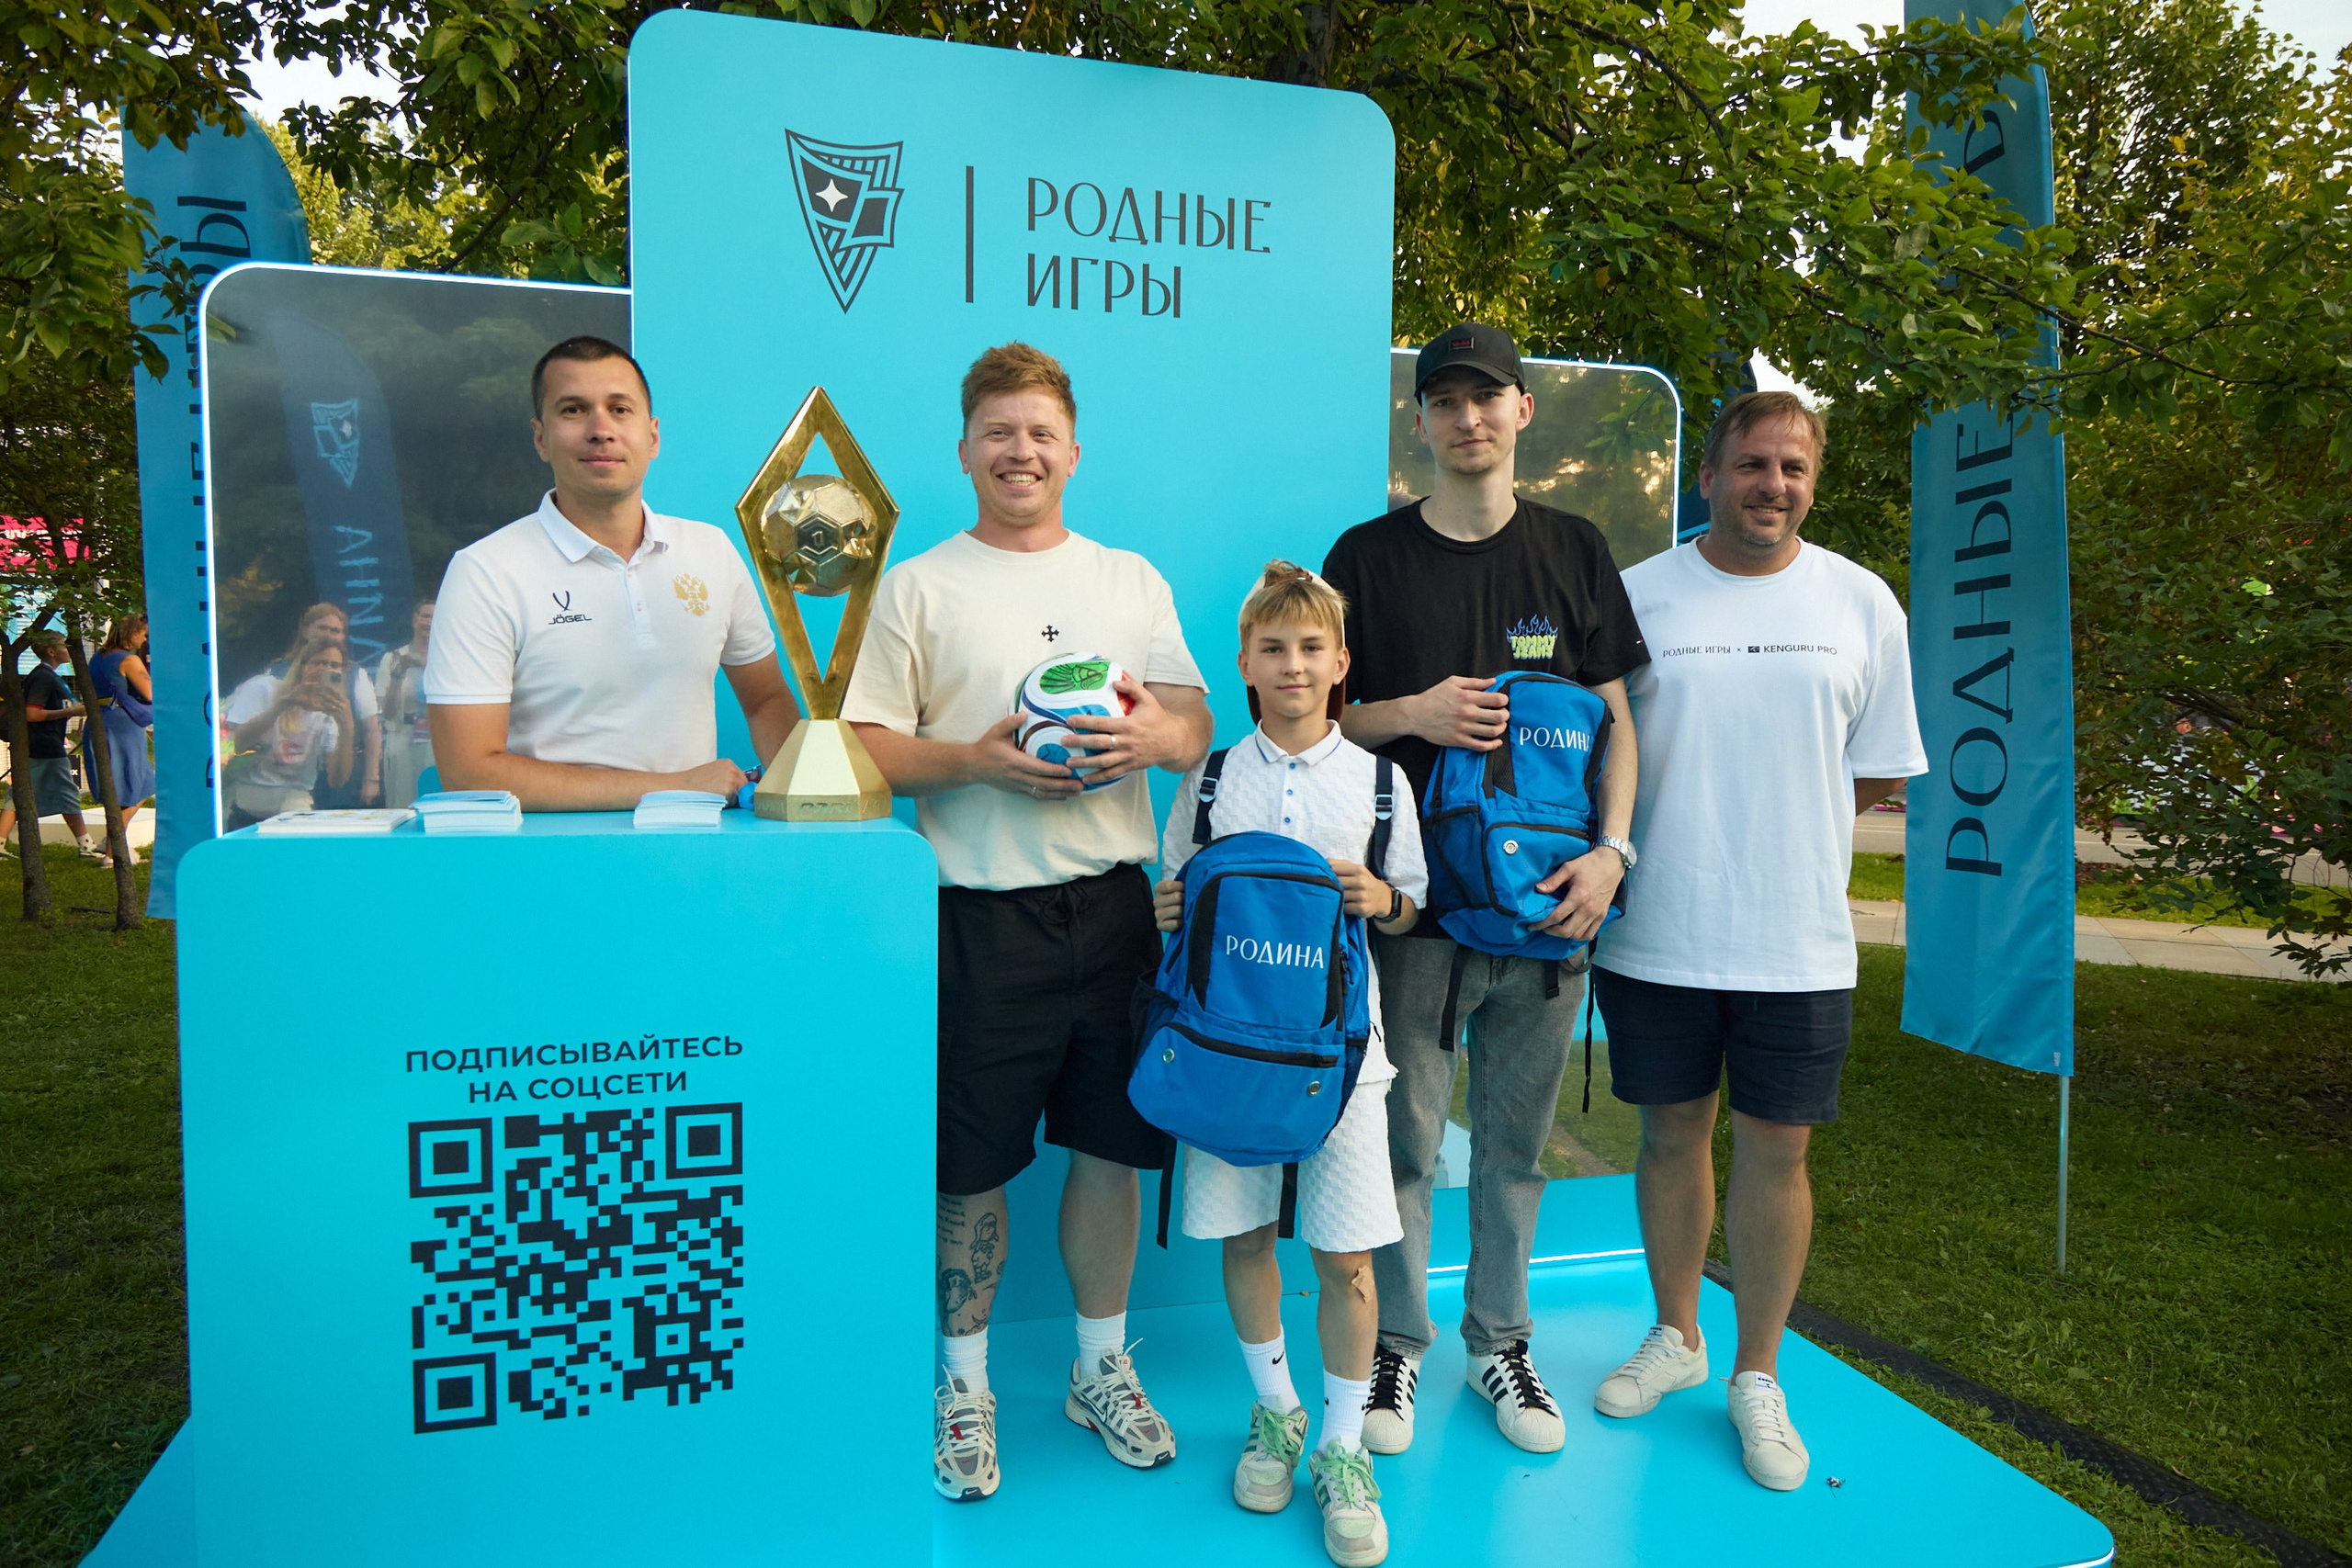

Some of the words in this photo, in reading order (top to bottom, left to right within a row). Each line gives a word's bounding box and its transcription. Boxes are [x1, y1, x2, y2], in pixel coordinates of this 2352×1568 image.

[1026, 175, 1272, 254] РОДНЫЕ
[1026, 253, 1182, 319] ИГРЫ
[548, 614, 593, 626] JÖGEL
[1510, 635, 1556, 649] TOMMY
[1512, 645, 1555, 660] JEANS
[1663, 645, 1702, 658] РОДНЫЕ
[1705, 645, 1731, 654] ИГРЫ
[1763, 645, 1815, 653] KENGURU
[1817, 645, 1838, 655] PRO
[1945, 413, 2015, 877] РОДНЫЕ
[1226, 934, 1324, 970] РОДИНА
[406, 1033, 743, 1075] ПОДПИСЫВАЙТЕСЬ
[469, 1080, 518, 1103] НА
[527, 1071, 687, 1100] СОЦСЕТИ
